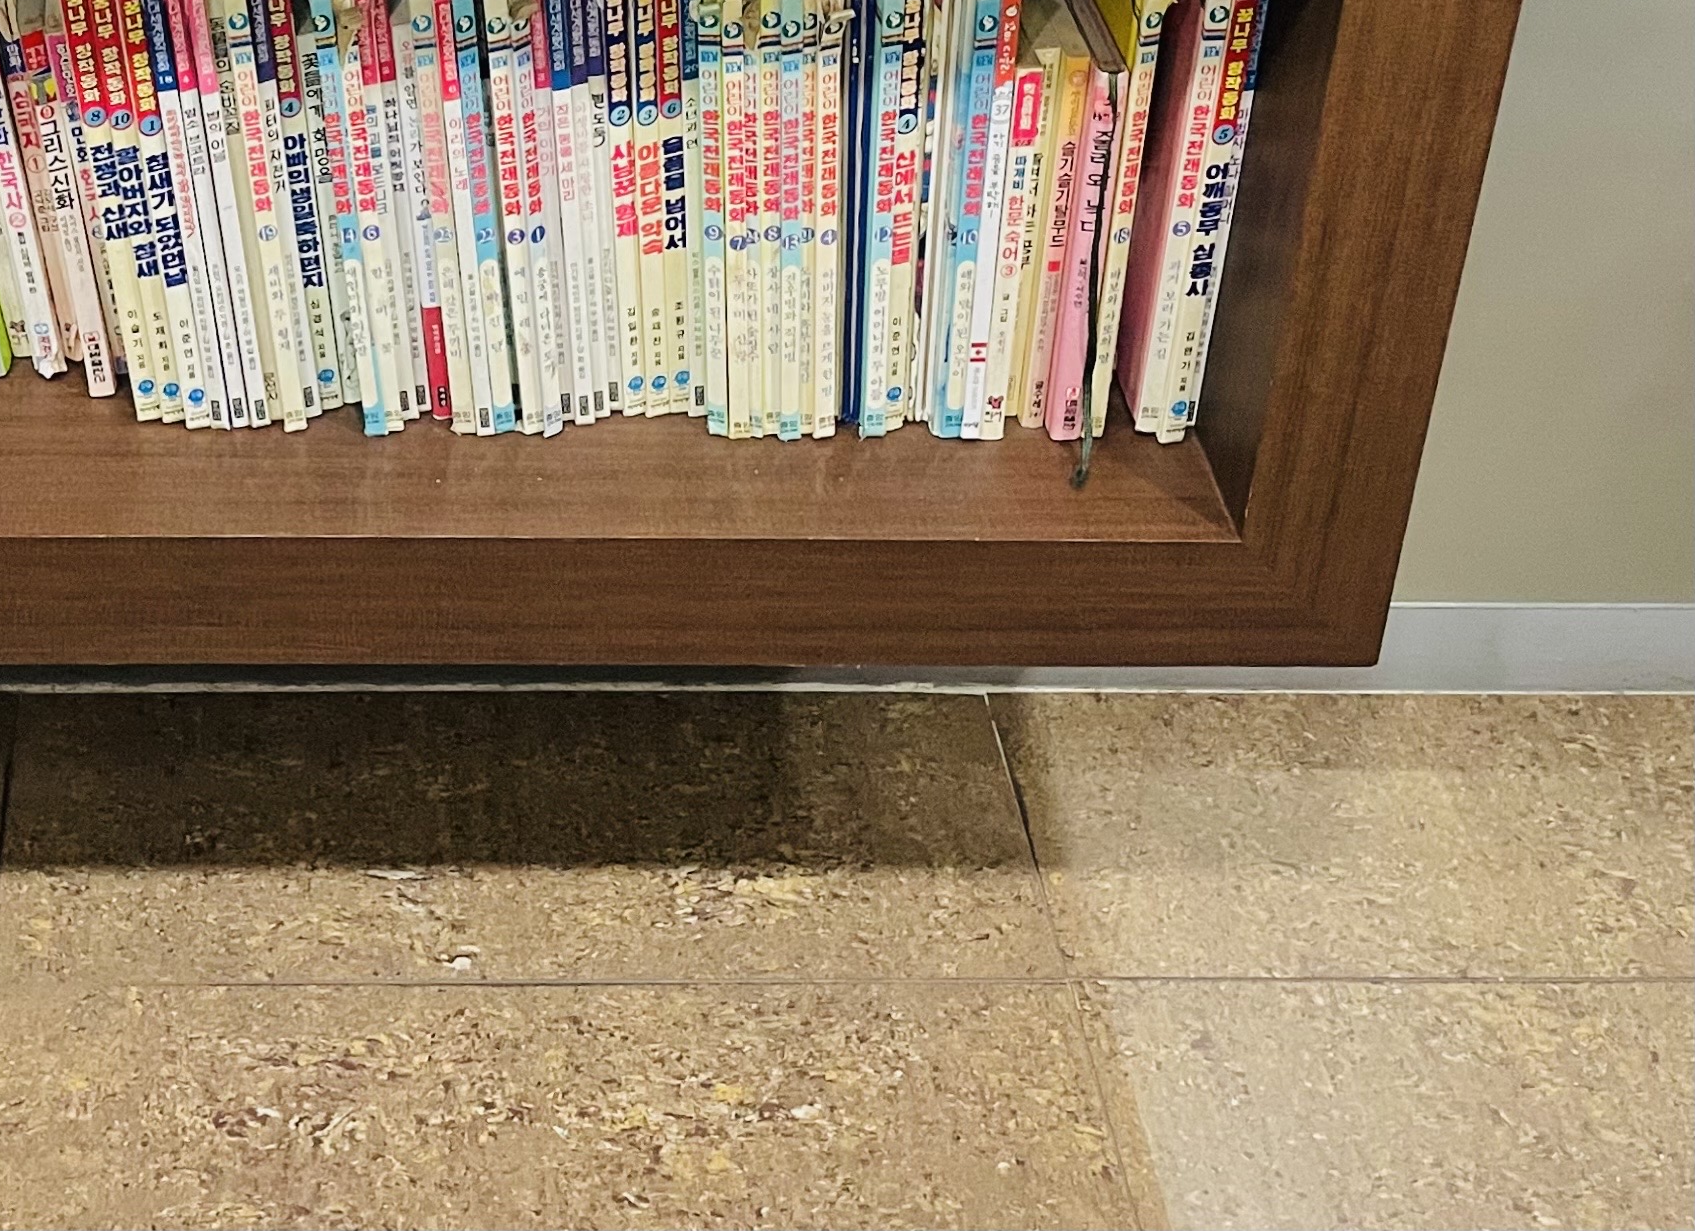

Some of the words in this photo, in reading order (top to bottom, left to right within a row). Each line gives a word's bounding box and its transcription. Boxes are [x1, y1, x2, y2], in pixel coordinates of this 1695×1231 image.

[283, 134, 310, 184] 아빠의
[53, 174, 74, 210] 신화
[115, 145, 153, 236] 할아버지와
[102, 206, 129, 241] 산새
